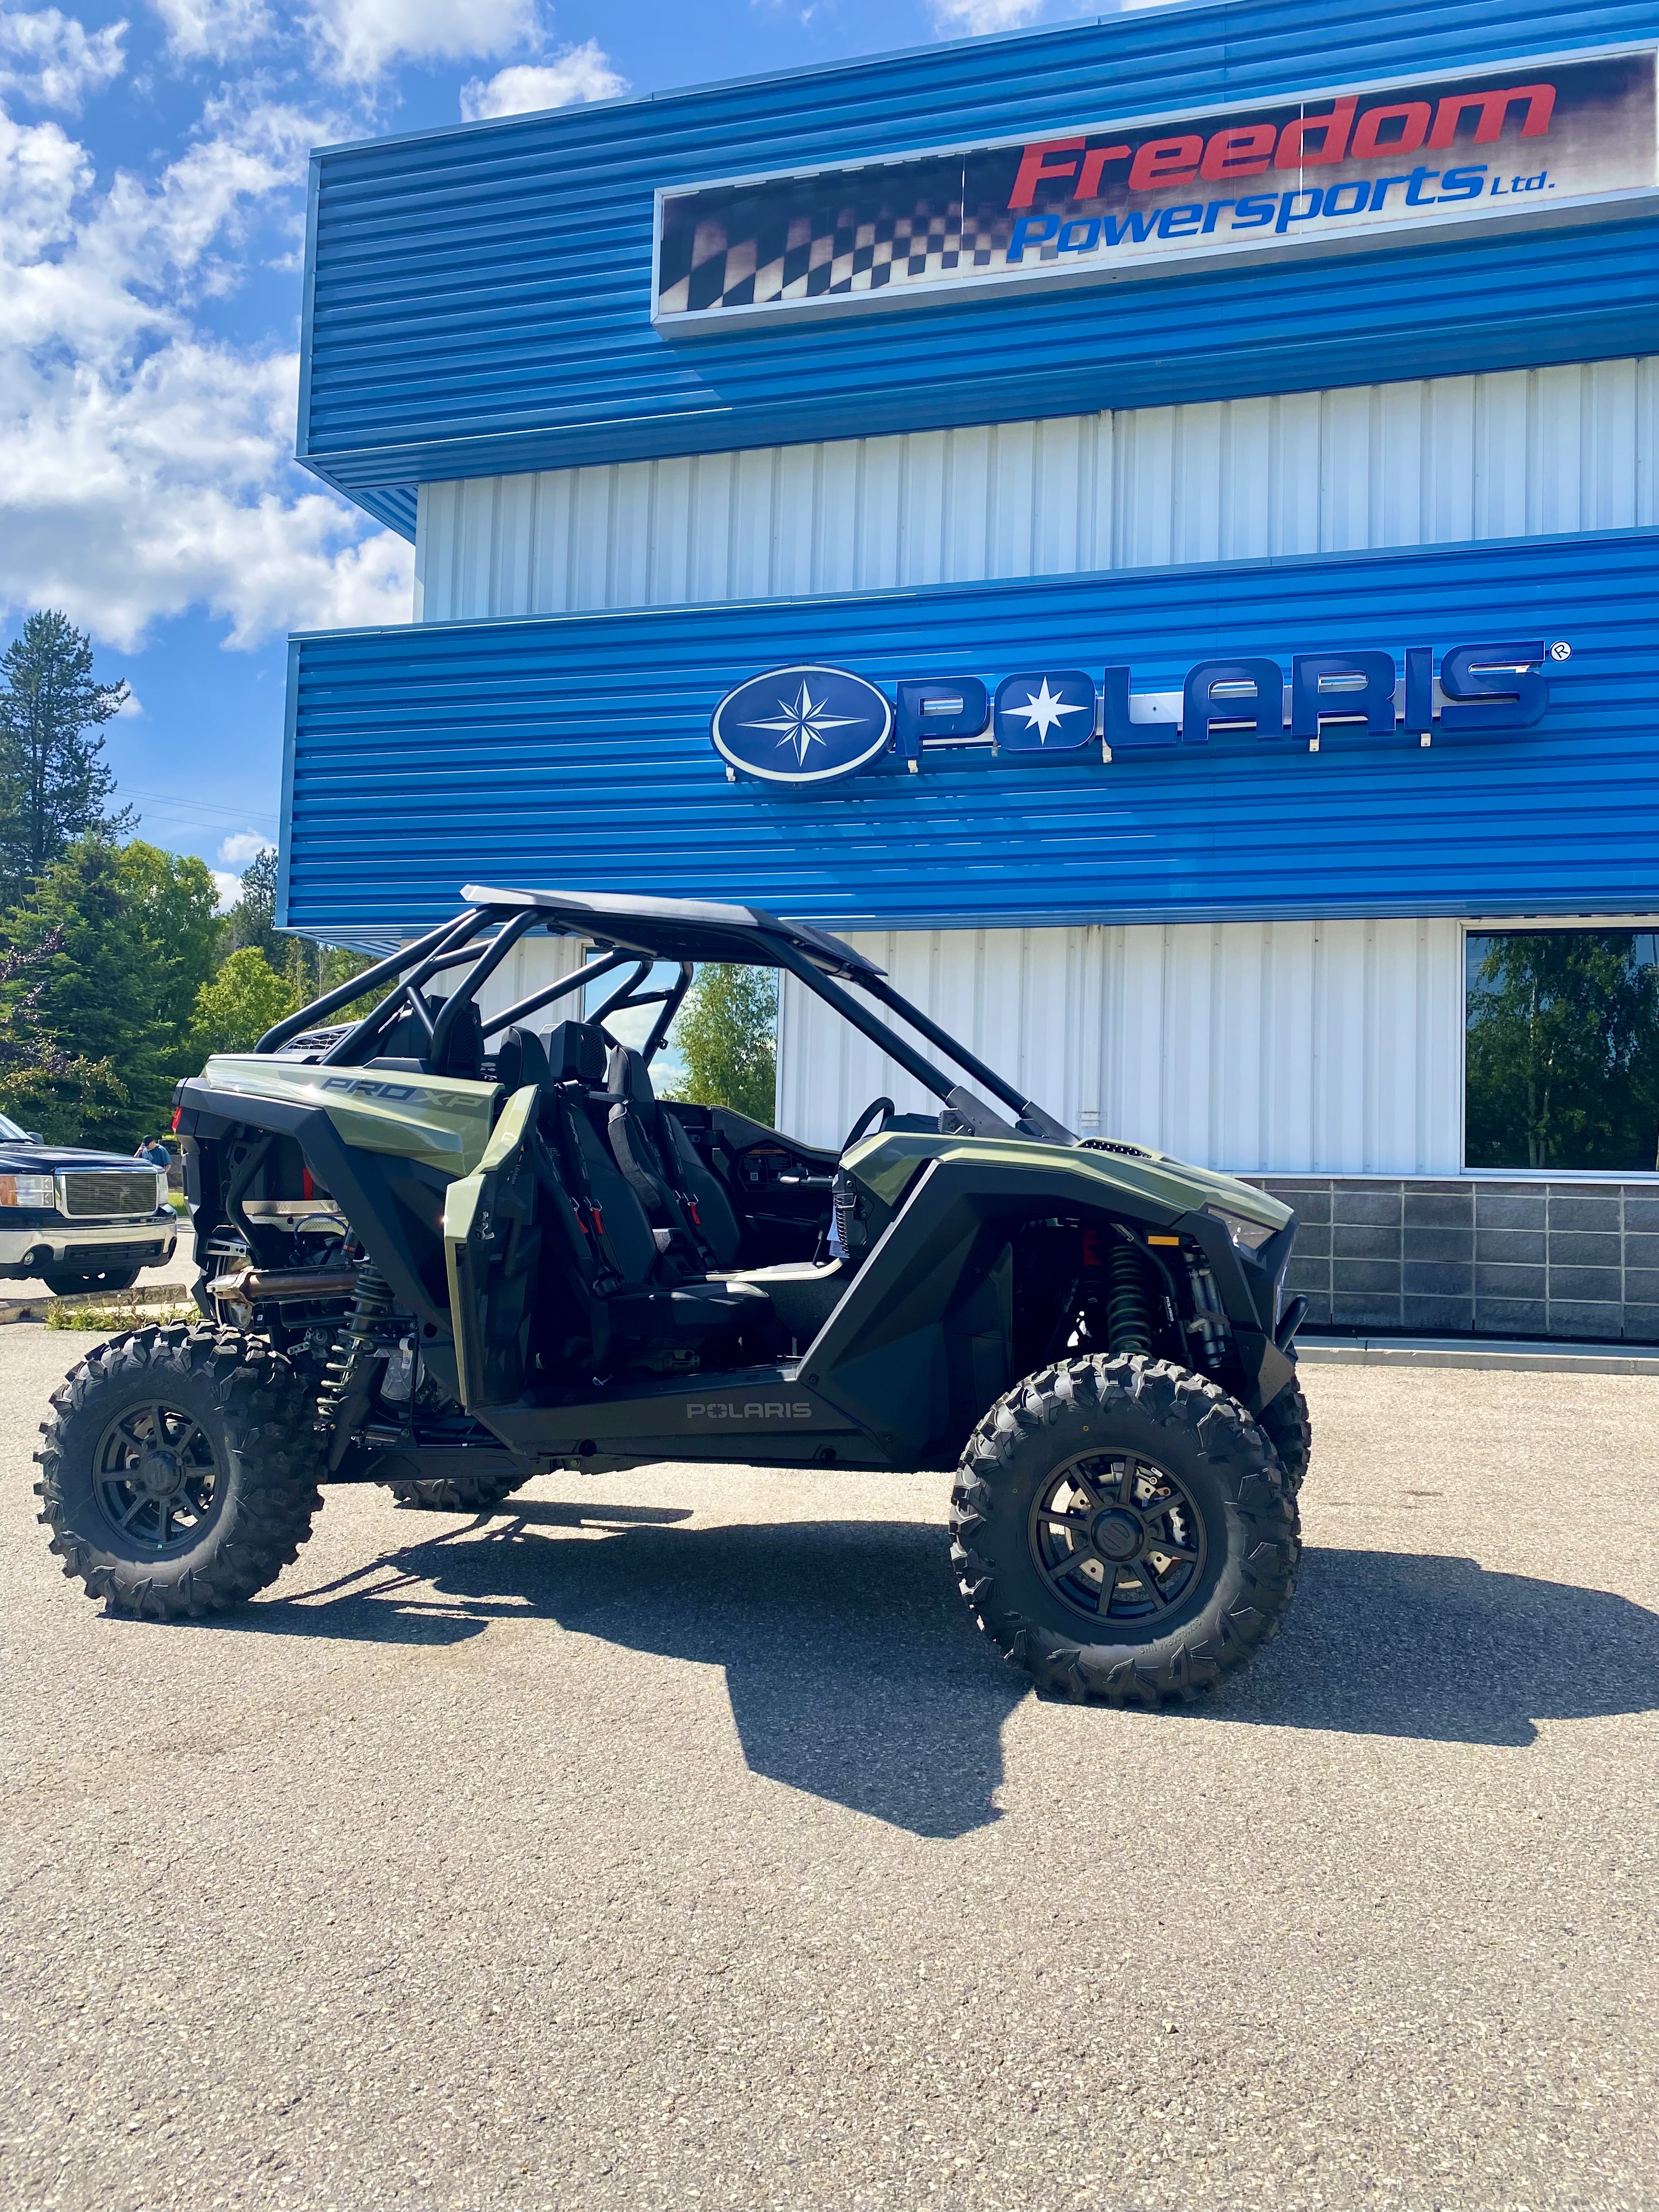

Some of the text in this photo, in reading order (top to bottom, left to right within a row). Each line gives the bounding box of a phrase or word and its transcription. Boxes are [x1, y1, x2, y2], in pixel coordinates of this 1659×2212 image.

[1007, 84, 1556, 208] Freedom
[1007, 164, 1556, 260] Powersports Ltd.
[686, 1402, 812, 1419] POLARIS
